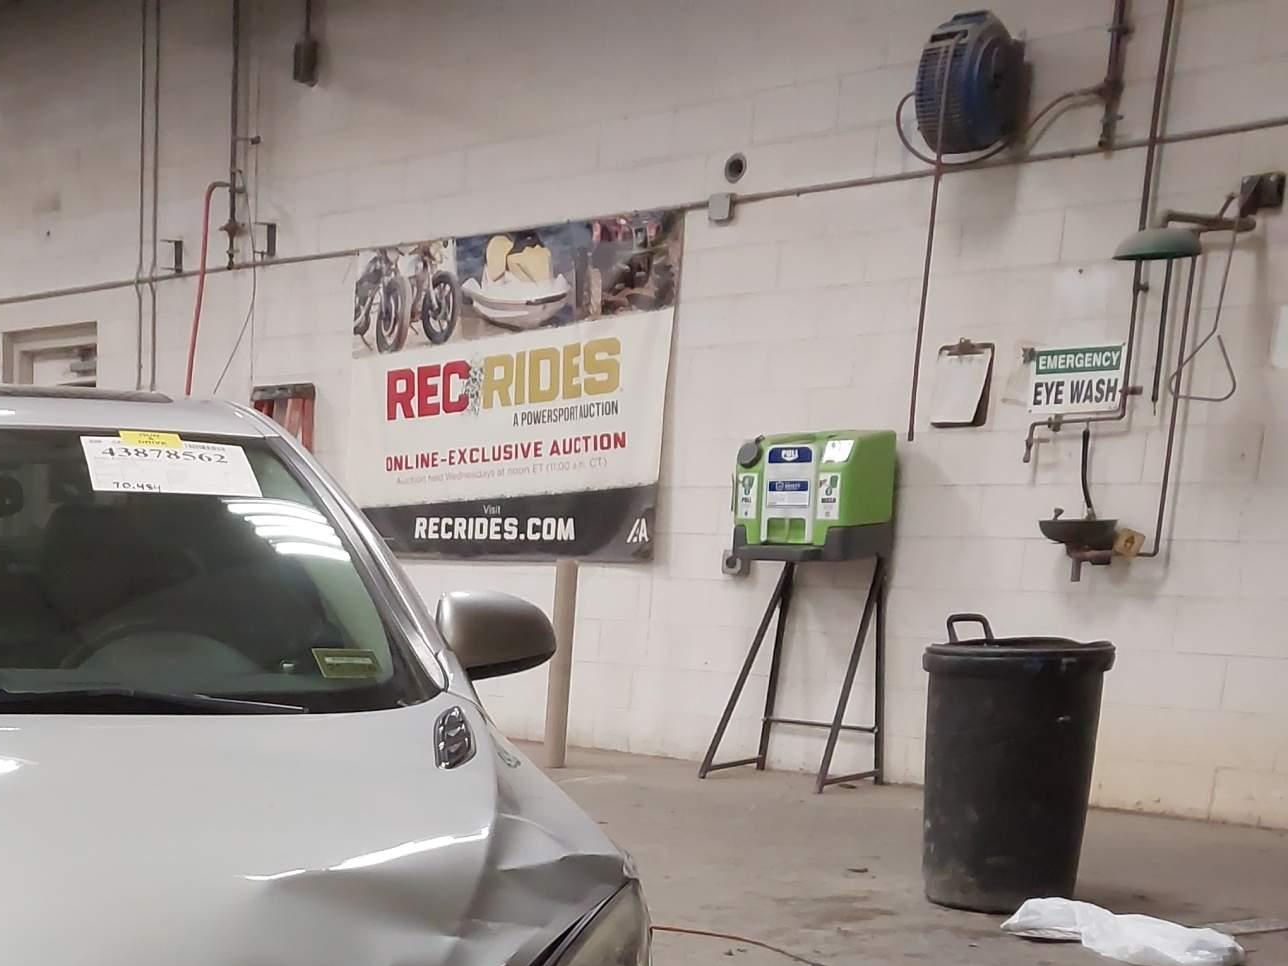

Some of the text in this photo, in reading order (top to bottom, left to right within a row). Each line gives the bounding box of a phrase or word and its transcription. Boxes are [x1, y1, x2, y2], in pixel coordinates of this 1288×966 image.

[1038, 351, 1121, 370] EMERGENCY
[386, 337, 621, 421] REC RIDES
[1032, 378, 1119, 406] EYE WASH
[512, 413, 519, 427] A
[100, 446, 229, 464] 43878562
[385, 431, 627, 472] ONLINE-EXCLUSIVE AUCTION
[483, 504, 501, 515] Visit
[414, 516, 576, 541] RECRIDES.COM
